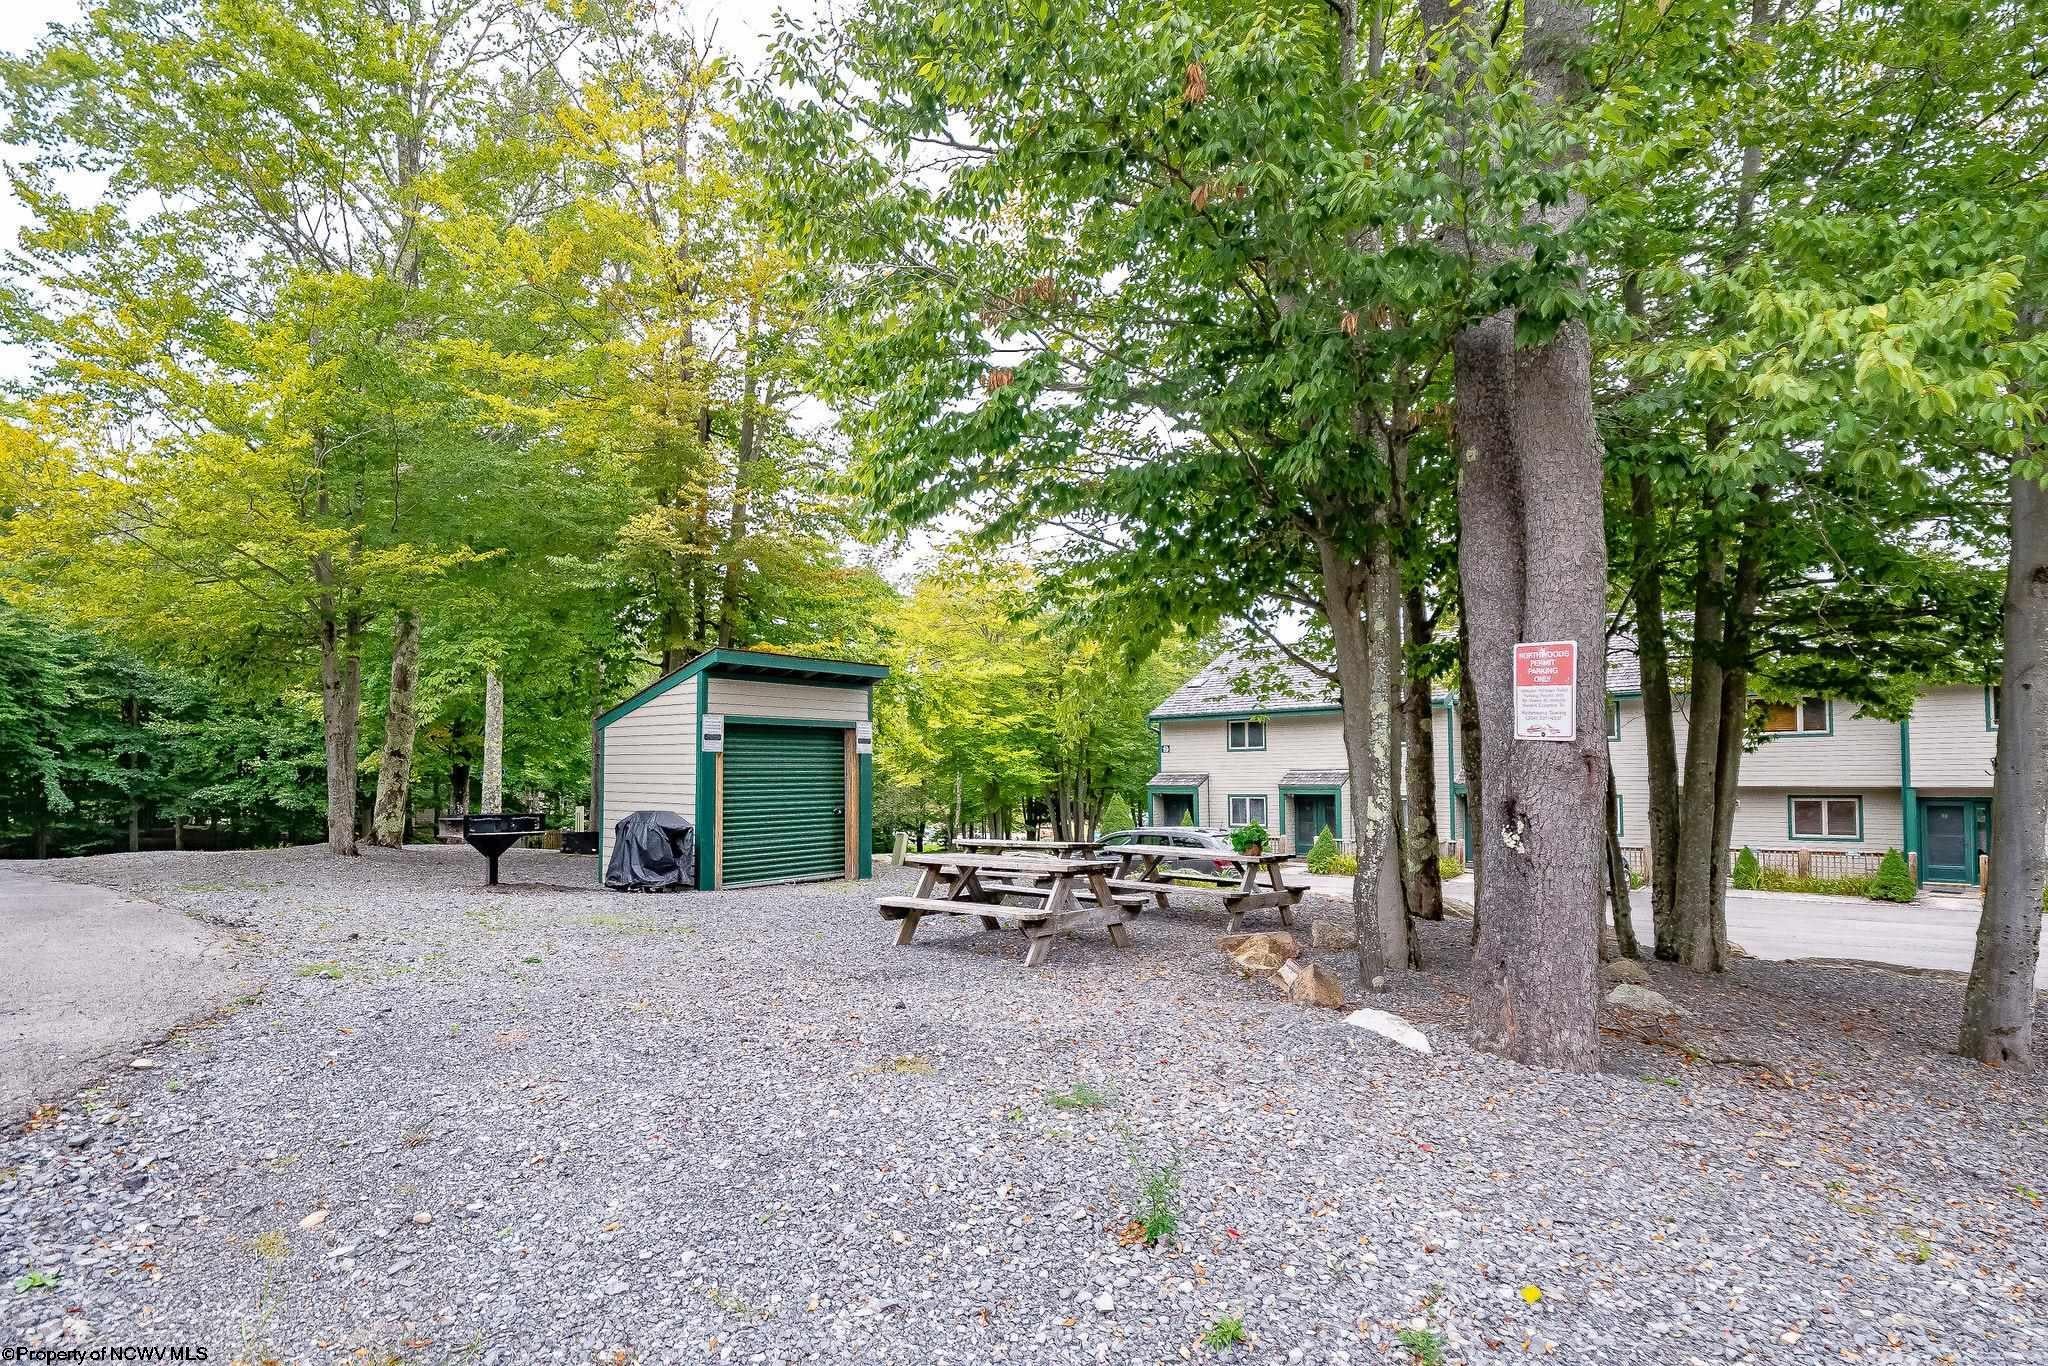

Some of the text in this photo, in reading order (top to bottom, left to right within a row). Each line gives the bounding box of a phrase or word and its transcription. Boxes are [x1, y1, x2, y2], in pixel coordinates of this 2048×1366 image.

[1519, 650, 1569, 660] NORTHWOODS
[1530, 659, 1557, 667] PERMIT
[1528, 667, 1559, 675] PARKING
